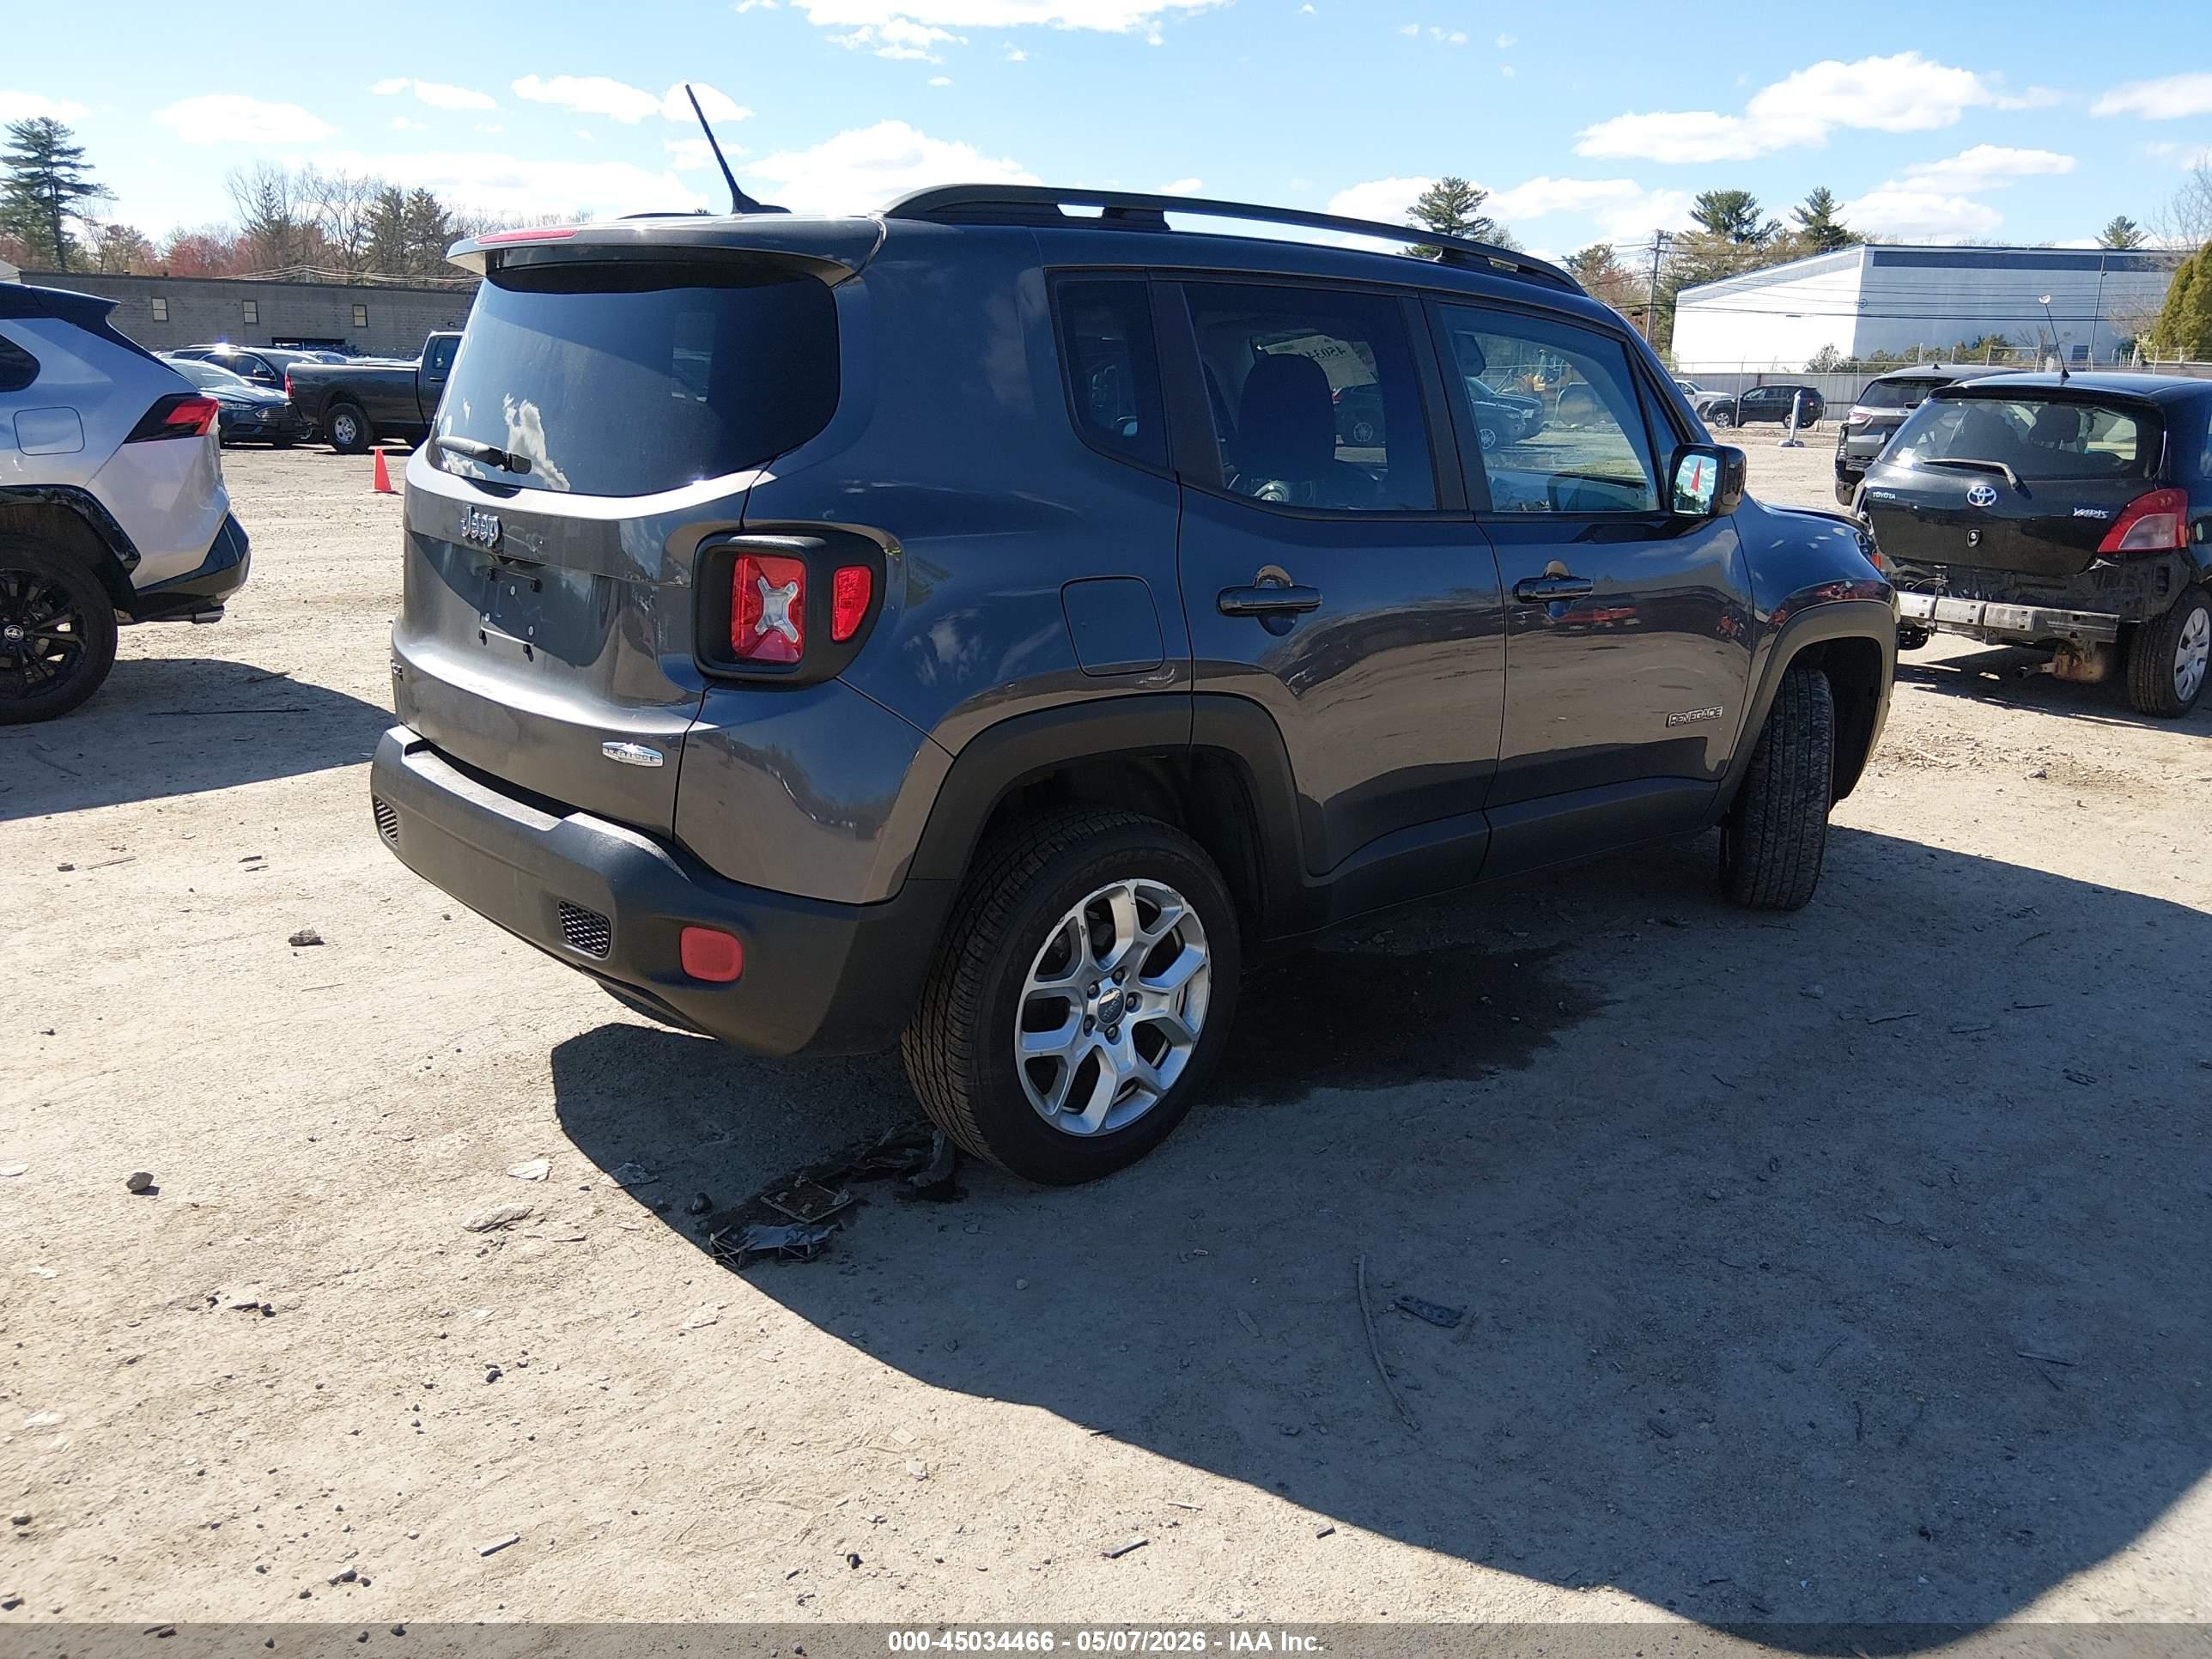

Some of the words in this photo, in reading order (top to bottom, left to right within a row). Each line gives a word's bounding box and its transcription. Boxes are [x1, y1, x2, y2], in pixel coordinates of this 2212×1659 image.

[1872, 491, 1896, 501] TOYOTA
[460, 505, 500, 549] Jeep
[1668, 706, 1723, 727] RENEGADE
